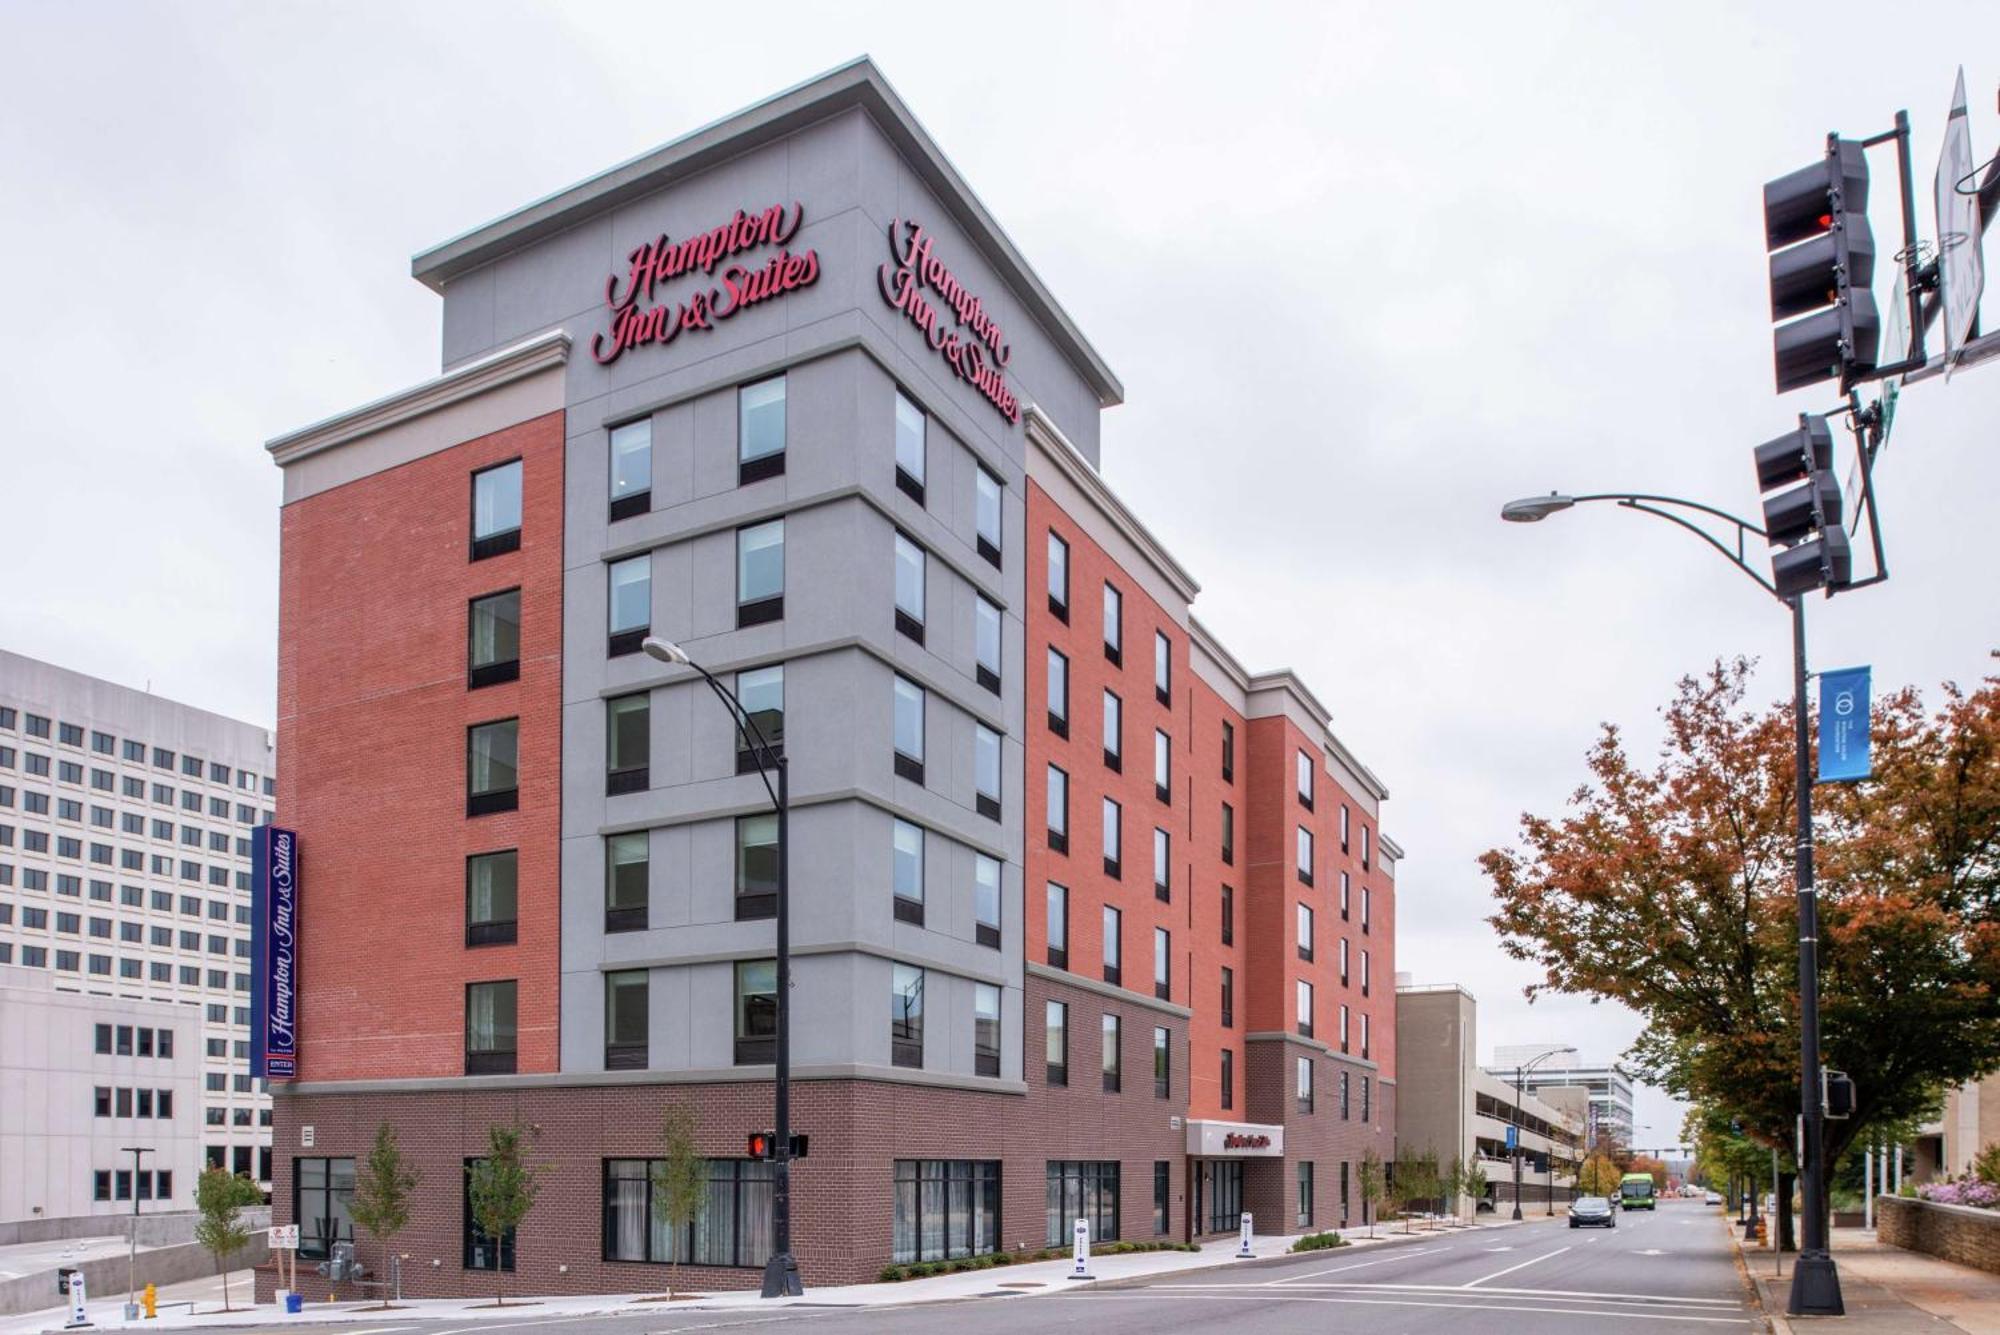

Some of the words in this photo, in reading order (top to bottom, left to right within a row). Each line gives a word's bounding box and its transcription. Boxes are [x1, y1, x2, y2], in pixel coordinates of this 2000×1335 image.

[606, 201, 803, 311] Hampton
[889, 217, 1010, 367] Hampton
[591, 303, 686, 365] Inn
[682, 292, 713, 330] &
[706, 249, 820, 321] Suites
[877, 263, 948, 353] Inn
[943, 331, 965, 378] &
[960, 342, 1021, 425] Suites
[273, 834, 292, 887] Suites
[278, 886, 292, 899] &
[273, 897, 293, 947] Inn
[270, 948, 293, 1046] Hampton
[270, 1060, 293, 1069] ENTER
